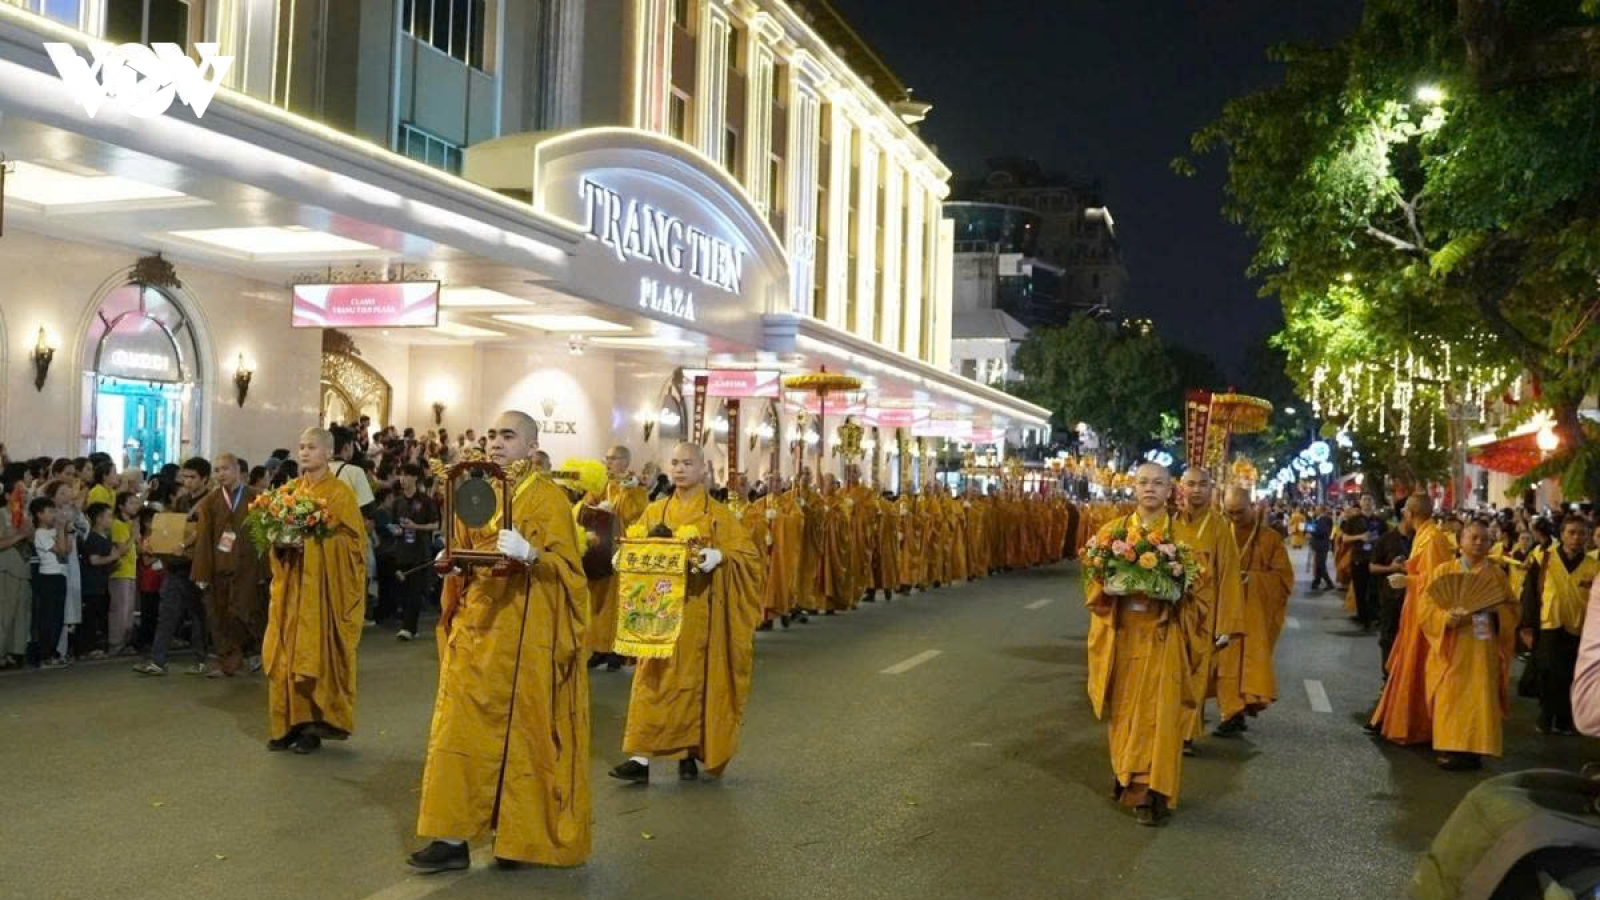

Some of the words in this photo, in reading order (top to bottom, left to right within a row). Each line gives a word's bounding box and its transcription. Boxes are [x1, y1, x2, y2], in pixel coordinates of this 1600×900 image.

[578, 174, 685, 273] TRANG
[686, 224, 746, 296] TIEN
[638, 276, 696, 322] PLAZA
